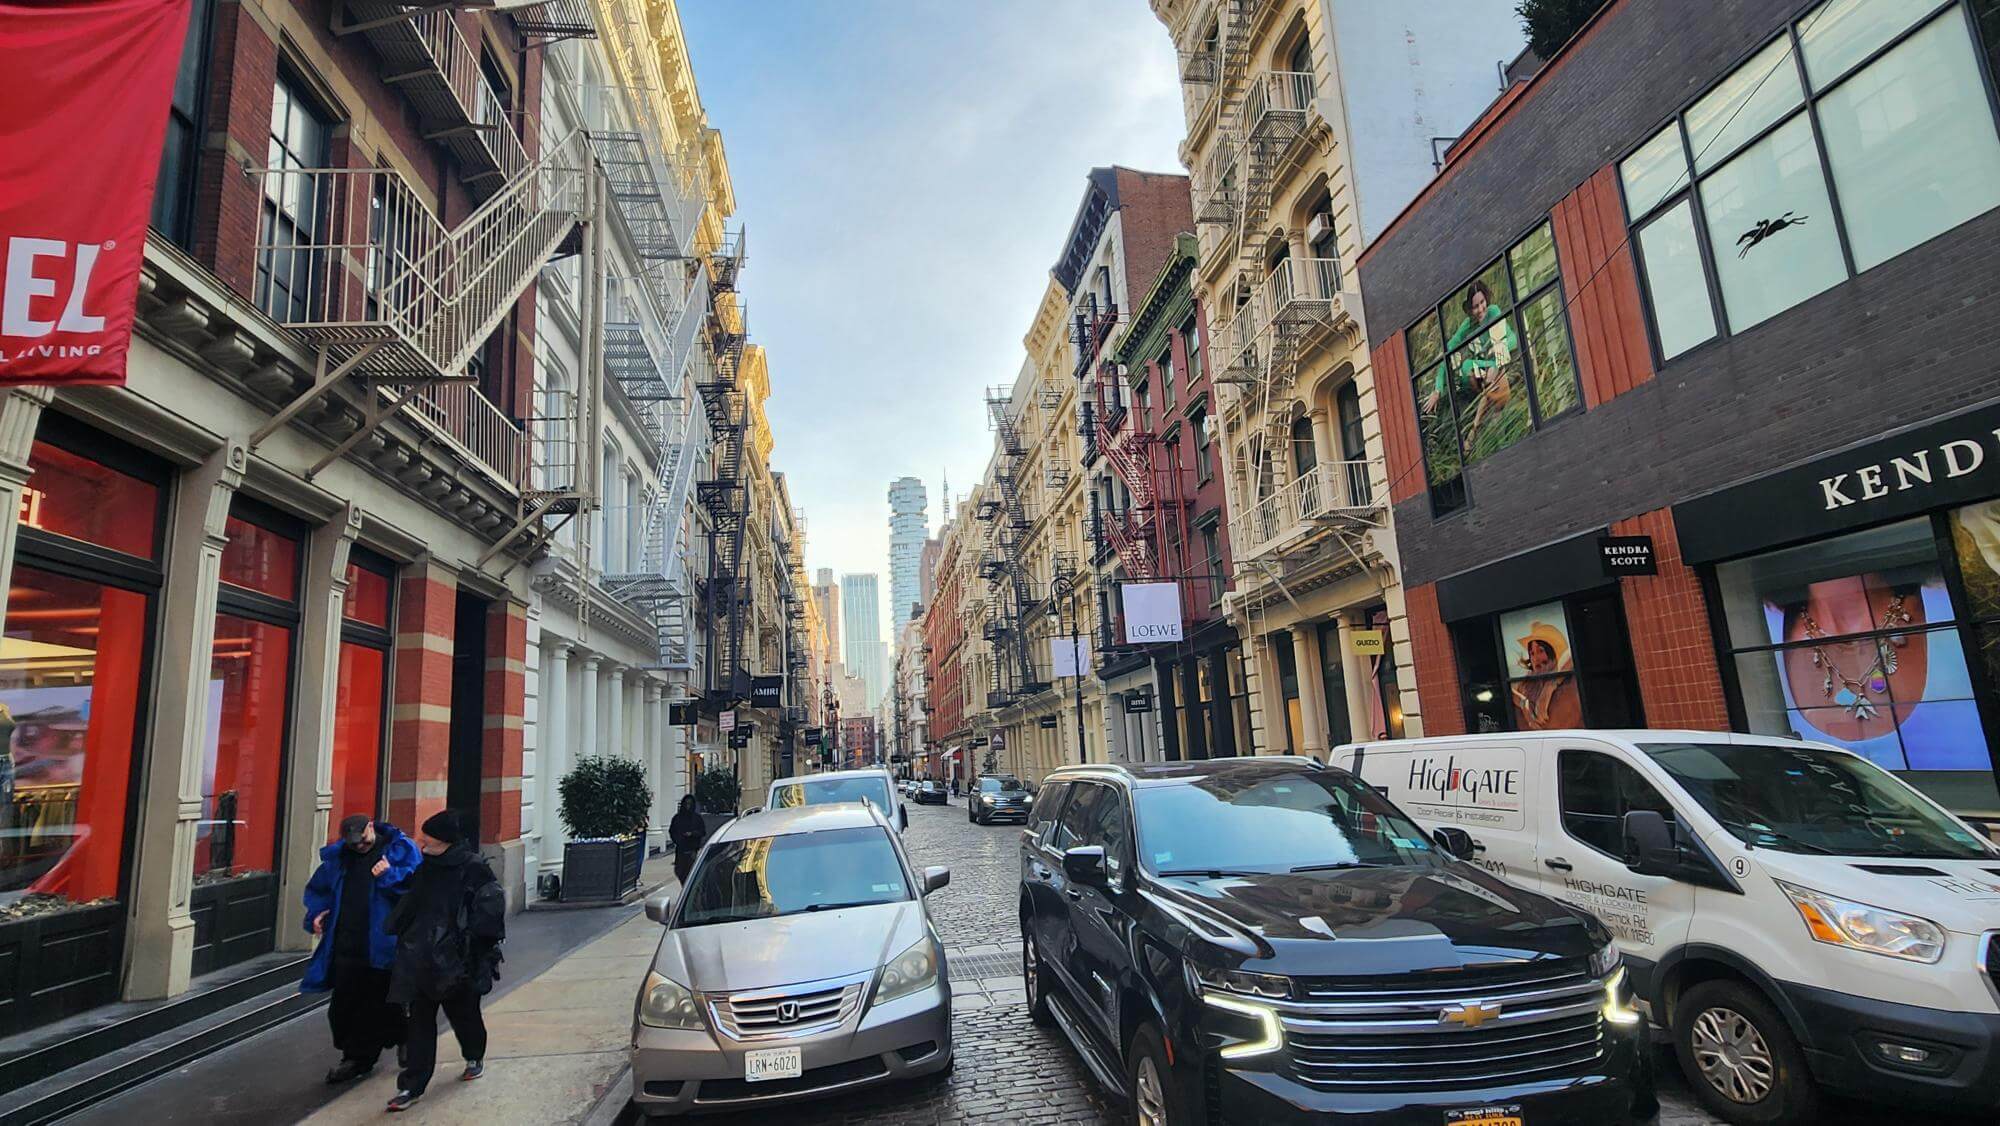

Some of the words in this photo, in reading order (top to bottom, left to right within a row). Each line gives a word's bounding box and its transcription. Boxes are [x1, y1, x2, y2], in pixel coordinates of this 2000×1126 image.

[1819, 429, 2000, 510] KEND
[1604, 546, 1649, 555] KENDRA
[1611, 556, 1646, 565] SCOTT
[1131, 623, 1178, 638] LOEWE
[753, 687, 779, 696] AMIRI
[1130, 698, 1146, 706] ami
[1735, 859, 1744, 875] 9
[1564, 878, 1648, 904] HIGHGATE
